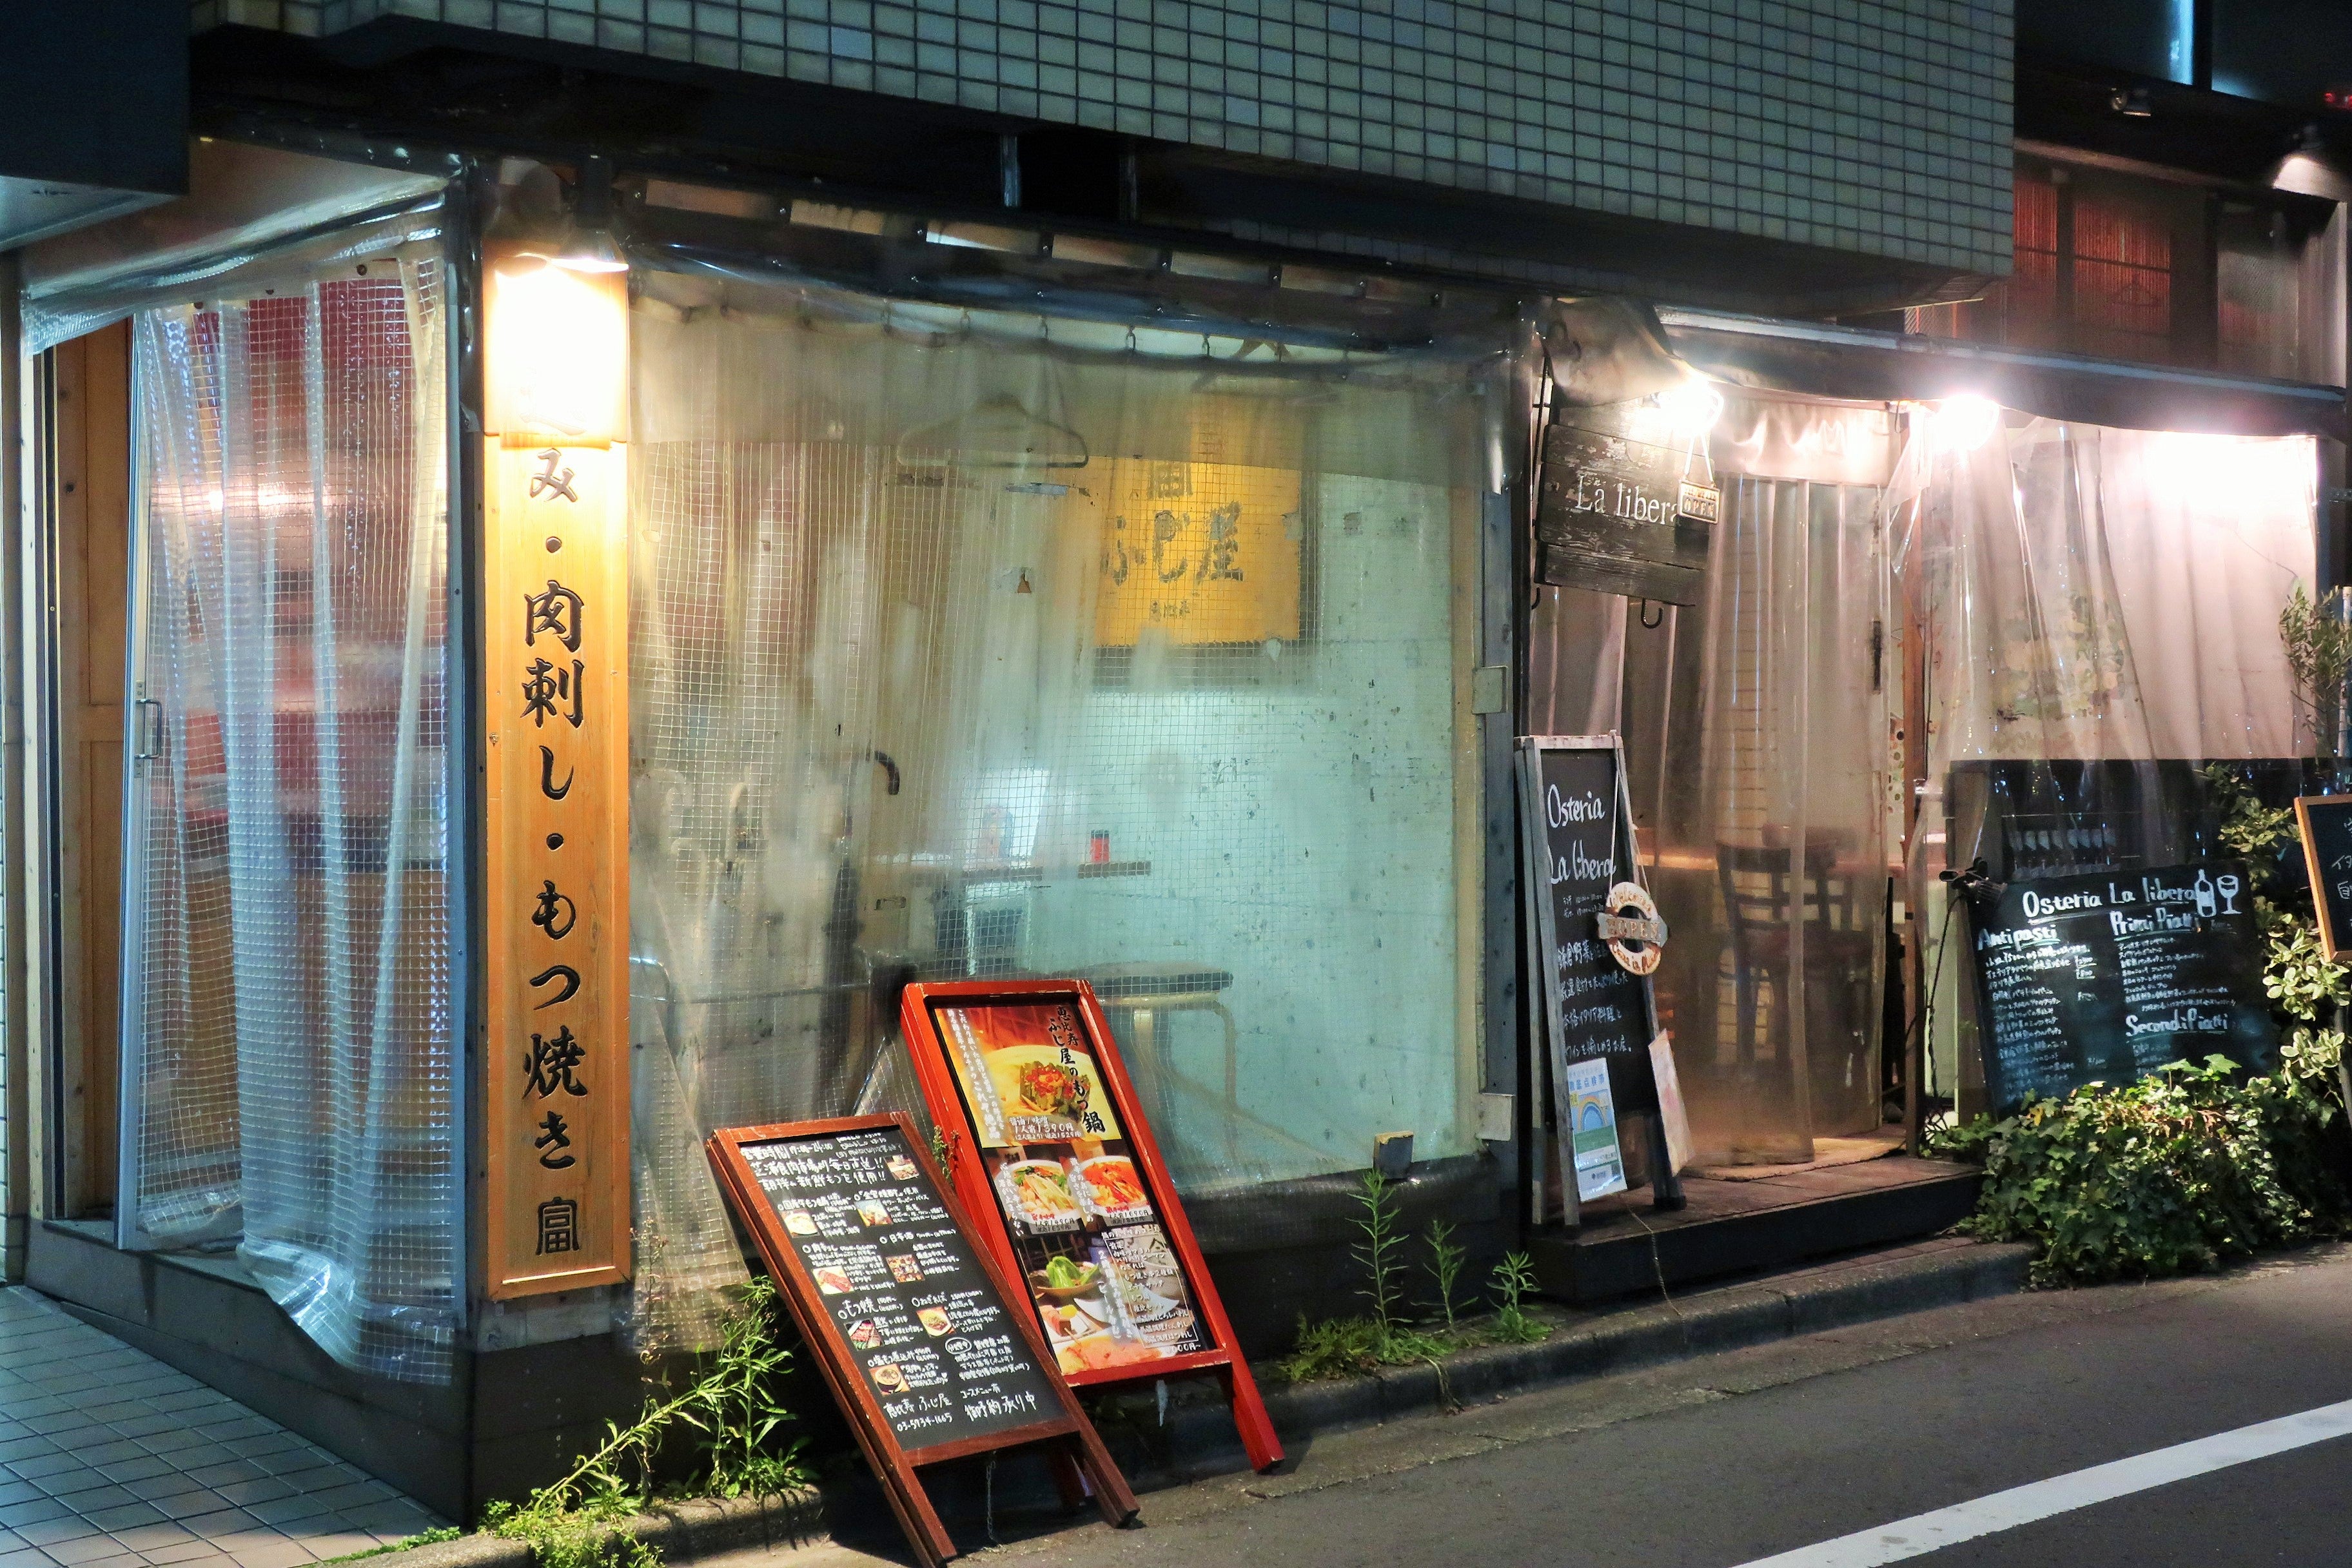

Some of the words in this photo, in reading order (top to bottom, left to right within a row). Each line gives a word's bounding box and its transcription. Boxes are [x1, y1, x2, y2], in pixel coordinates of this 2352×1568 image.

[1575, 475, 1606, 514] La
[1683, 497, 1715, 517] OPEN
[520, 416, 588, 1170] み・肉刺し・もつ焼き
[1548, 783, 1606, 828] Osteria
[1547, 844, 1571, 885] La
[1572, 839, 1617, 881] libera
[2022, 890, 2103, 918] Osteria
[2109, 882, 2136, 904] La
[2142, 877, 2197, 903] libera
[1977, 924, 2059, 952] Antipasti
[2110, 910, 2154, 936] Primi
[1056, 1005, 1079, 1046] 恵比寿
[2125, 1008, 2188, 1037] Secondi
[2187, 1007, 2228, 1031] Piatti
[1048, 1018, 1106, 1133] ふじ屋のもつ鍋
[740, 1144, 790, 1161] 営業時間
[883, 1398, 915, 1419] 恵比寿
[918, 1393, 953, 1412] ふじ屋
[963, 1390, 1037, 1422] 御予約承り中
